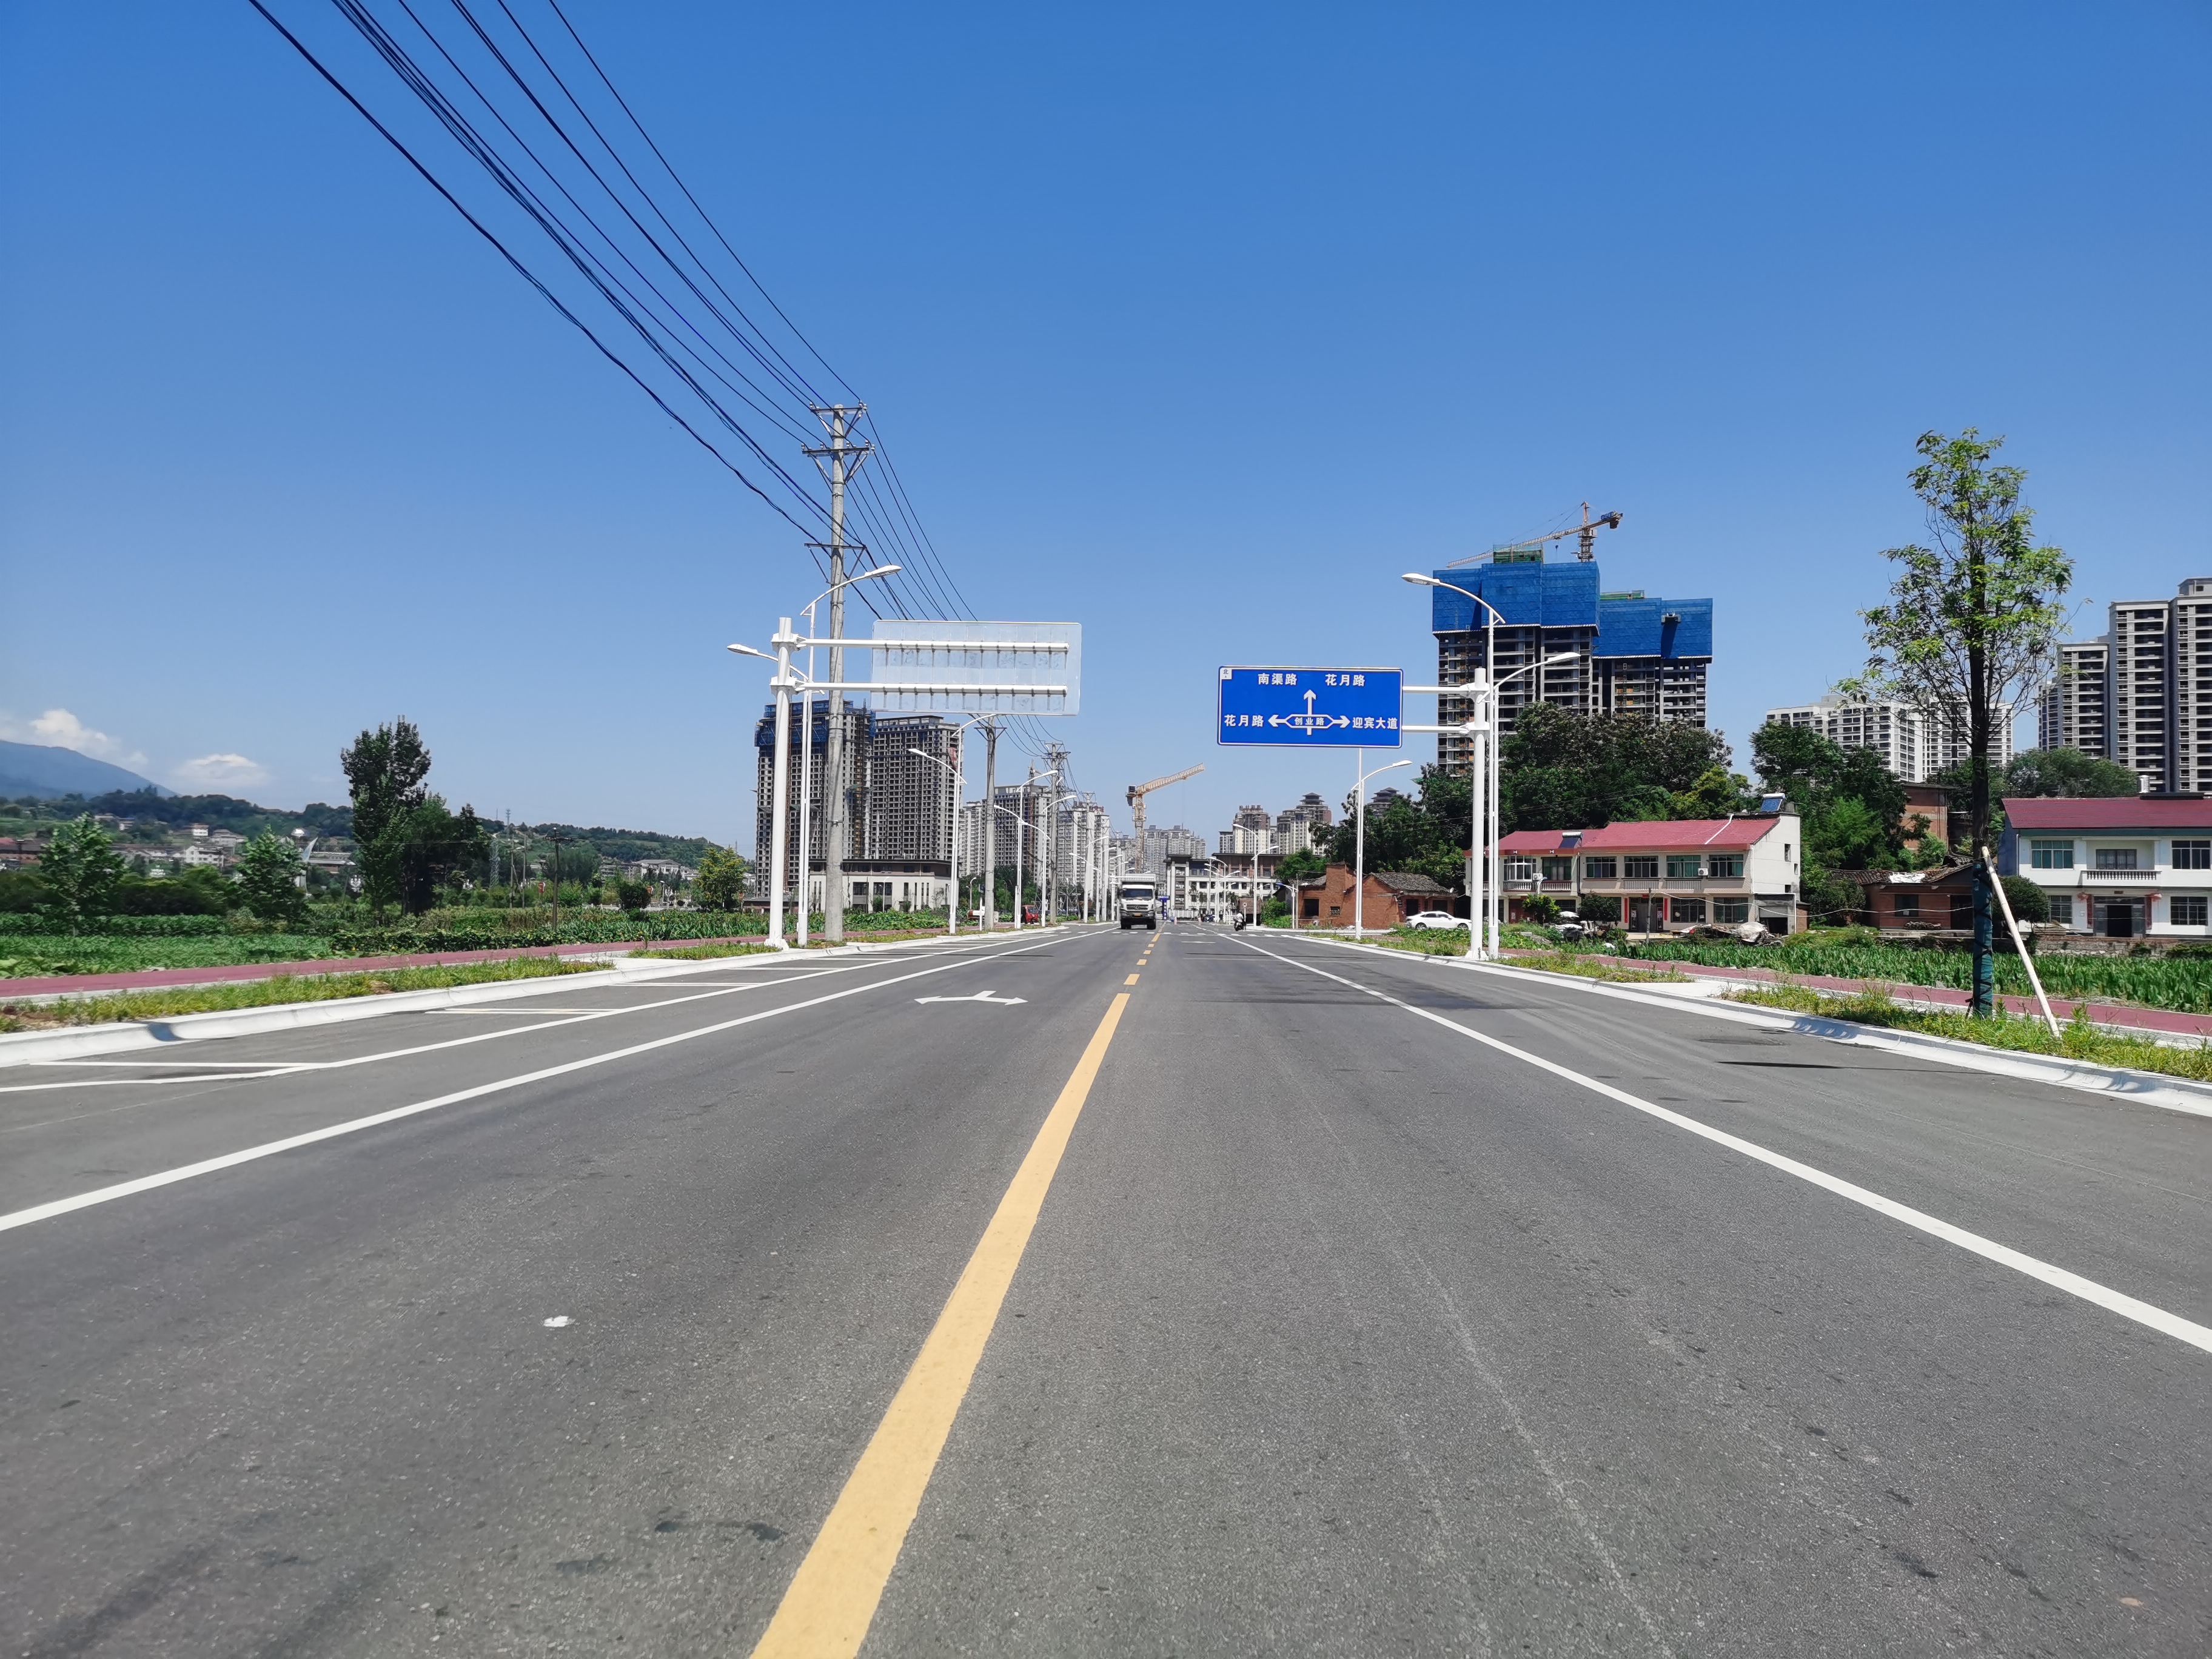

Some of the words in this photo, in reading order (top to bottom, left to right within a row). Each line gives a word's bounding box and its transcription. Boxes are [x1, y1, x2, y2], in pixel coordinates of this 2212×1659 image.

[1258, 673, 1297, 685] 南渠路
[1325, 674, 1365, 686] 花月路
[1224, 714, 1264, 727] 花月路
[1294, 717, 1324, 726] 创业路
[1352, 717, 1398, 729] 迎宾大道
